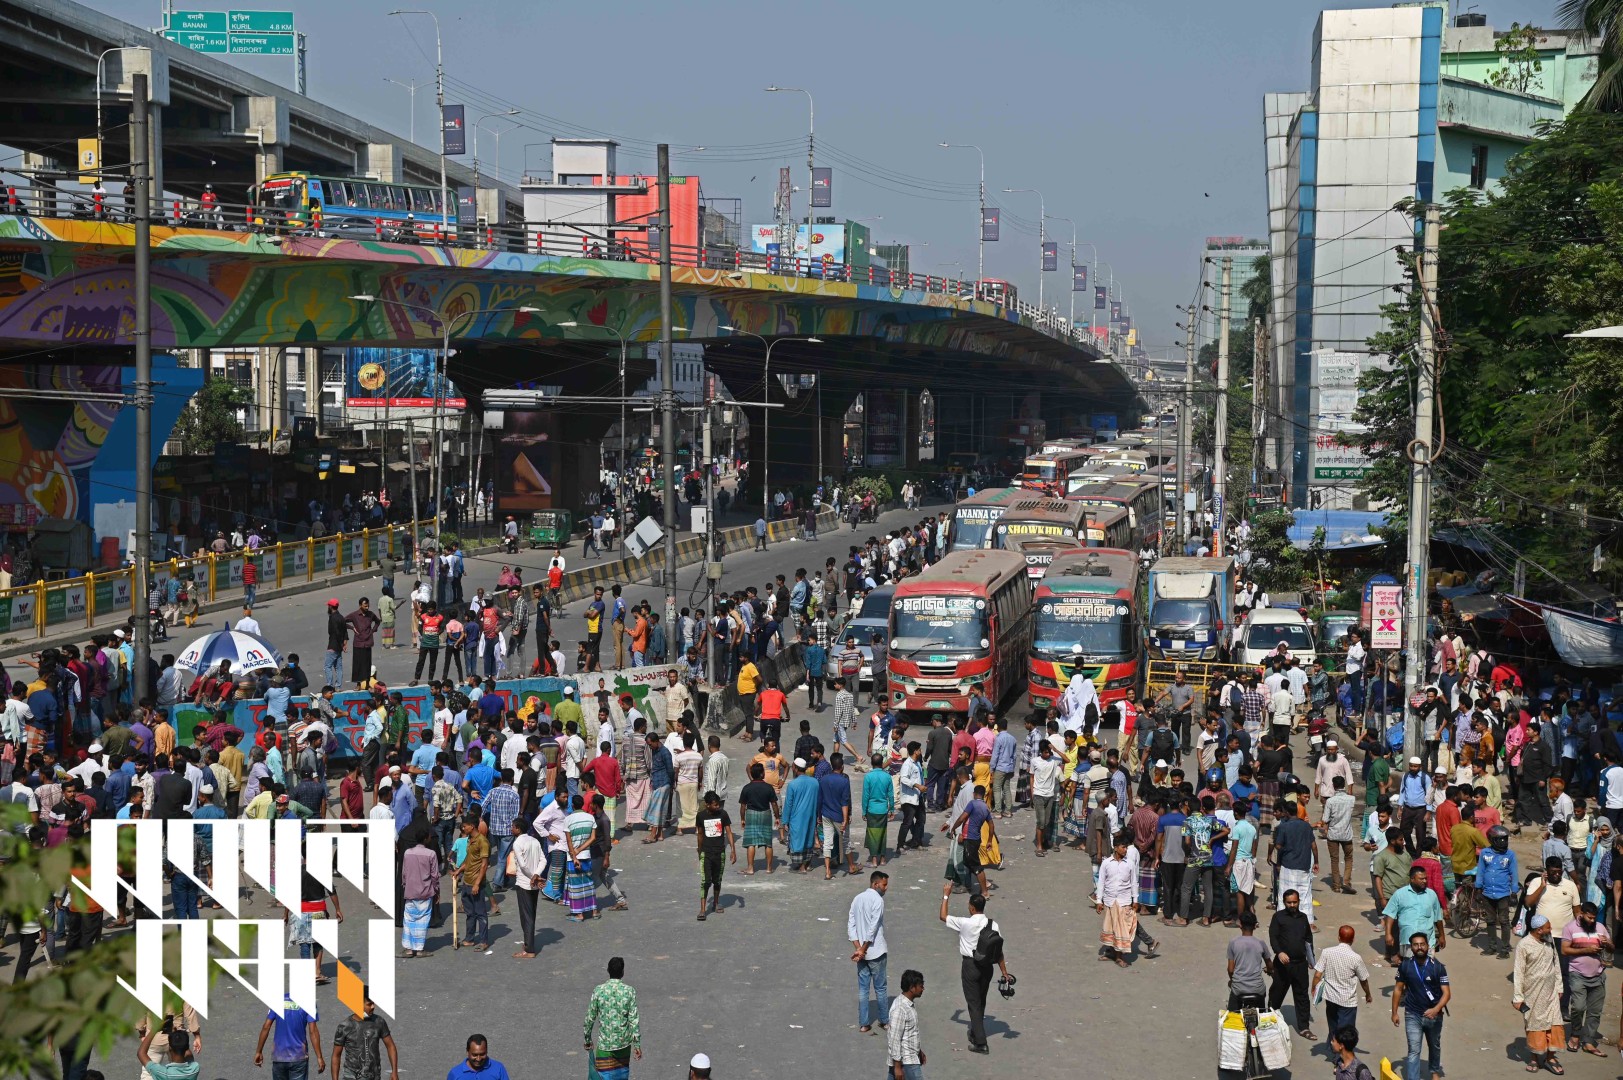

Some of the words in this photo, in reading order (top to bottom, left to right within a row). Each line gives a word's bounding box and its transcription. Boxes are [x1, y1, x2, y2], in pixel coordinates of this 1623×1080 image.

[187, 13, 204, 21] বনানী
[231, 13, 250, 21] কুড়িল
[955, 508, 989, 519] ANANNA
[295, 562, 307, 570] WALTON
[263, 568, 276, 577] WALTON
[114, 595, 131, 605] WALTON
[903, 596, 946, 611] মনজিল
[67, 604, 85, 615] WALTON
[12, 613, 31, 623] WALTON
[177, 659, 198, 670] MARCEL
[242, 659, 273, 669] MARCEL
